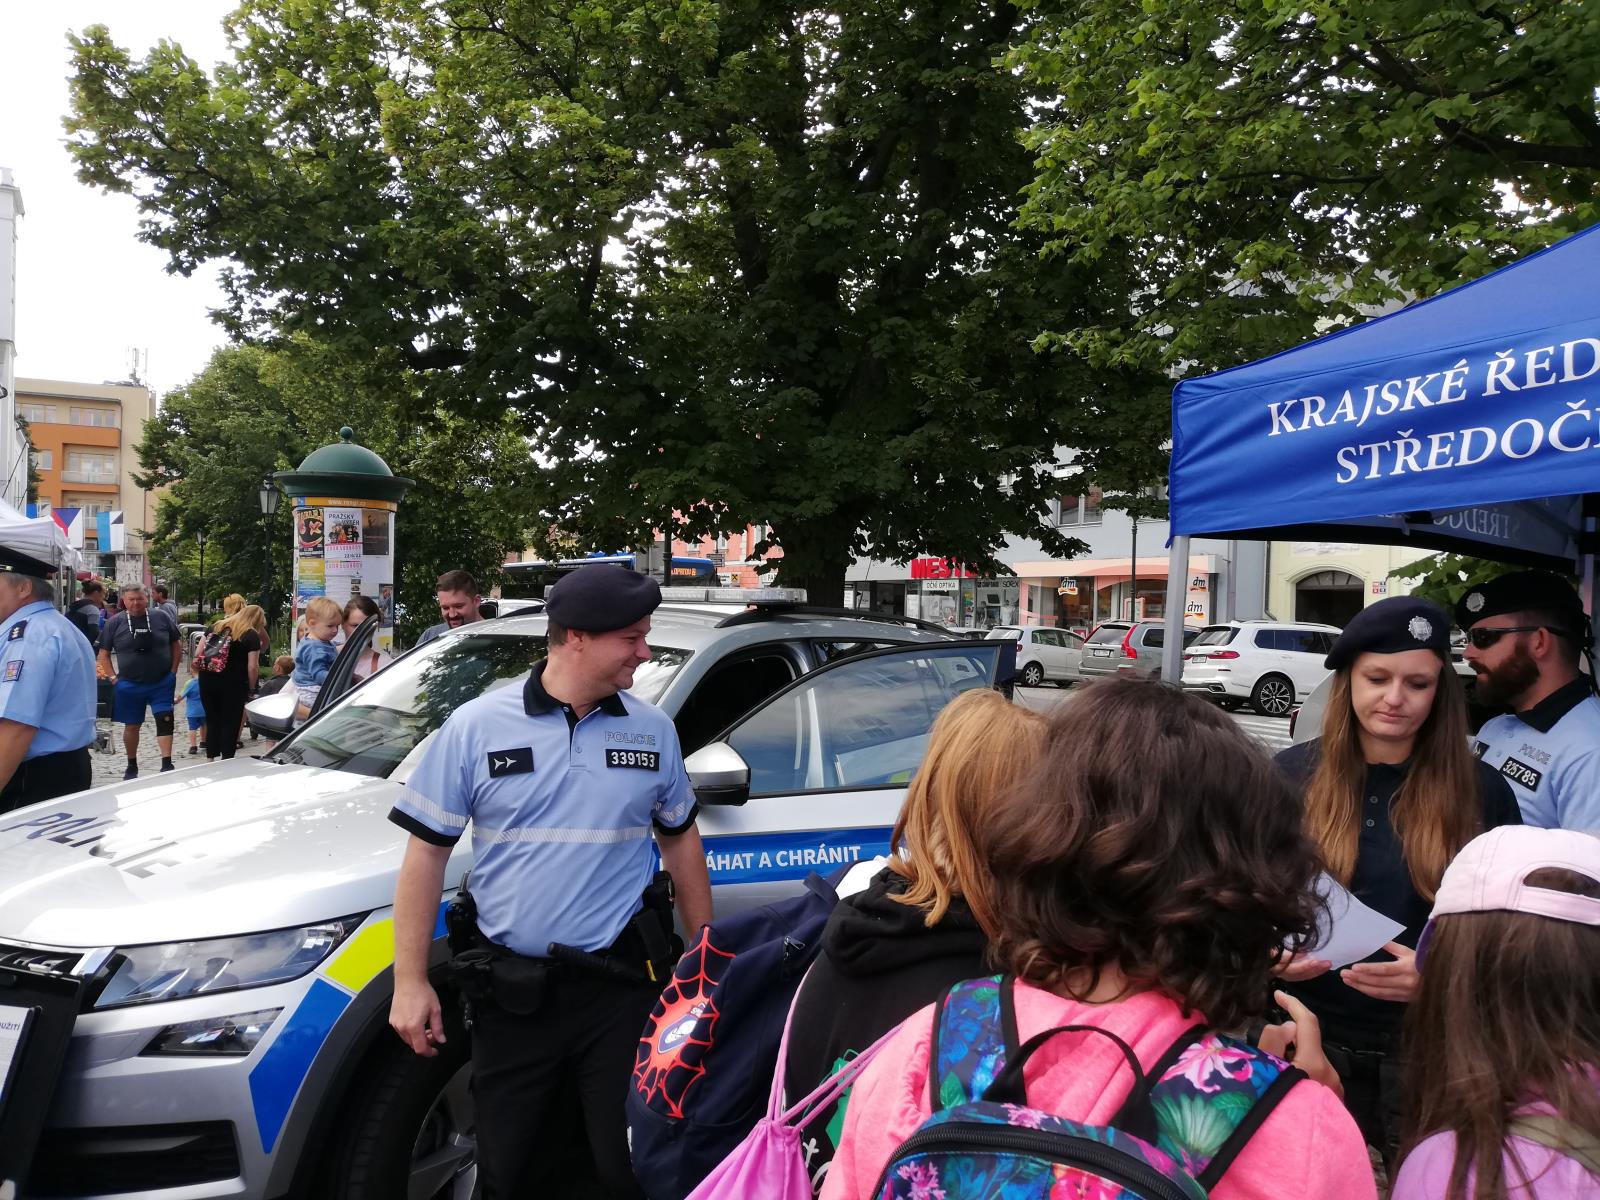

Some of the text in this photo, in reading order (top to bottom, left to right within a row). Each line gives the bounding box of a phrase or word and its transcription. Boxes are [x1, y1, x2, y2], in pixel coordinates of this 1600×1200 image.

[1267, 337, 1600, 437] KRAJSKÉ ŘED
[1336, 398, 1600, 484] STŘEDOČ
[1061, 577, 1076, 588] dm
[1193, 576, 1205, 587] dm
[1187, 601, 1203, 612] dm
[605, 730, 656, 746] POLICIE
[611, 751, 655, 768] 339153
[758, 854, 773, 869] A
[776, 843, 861, 867] CHRÁNIT
[0, 1021, 20, 1031] UŽITÍ
